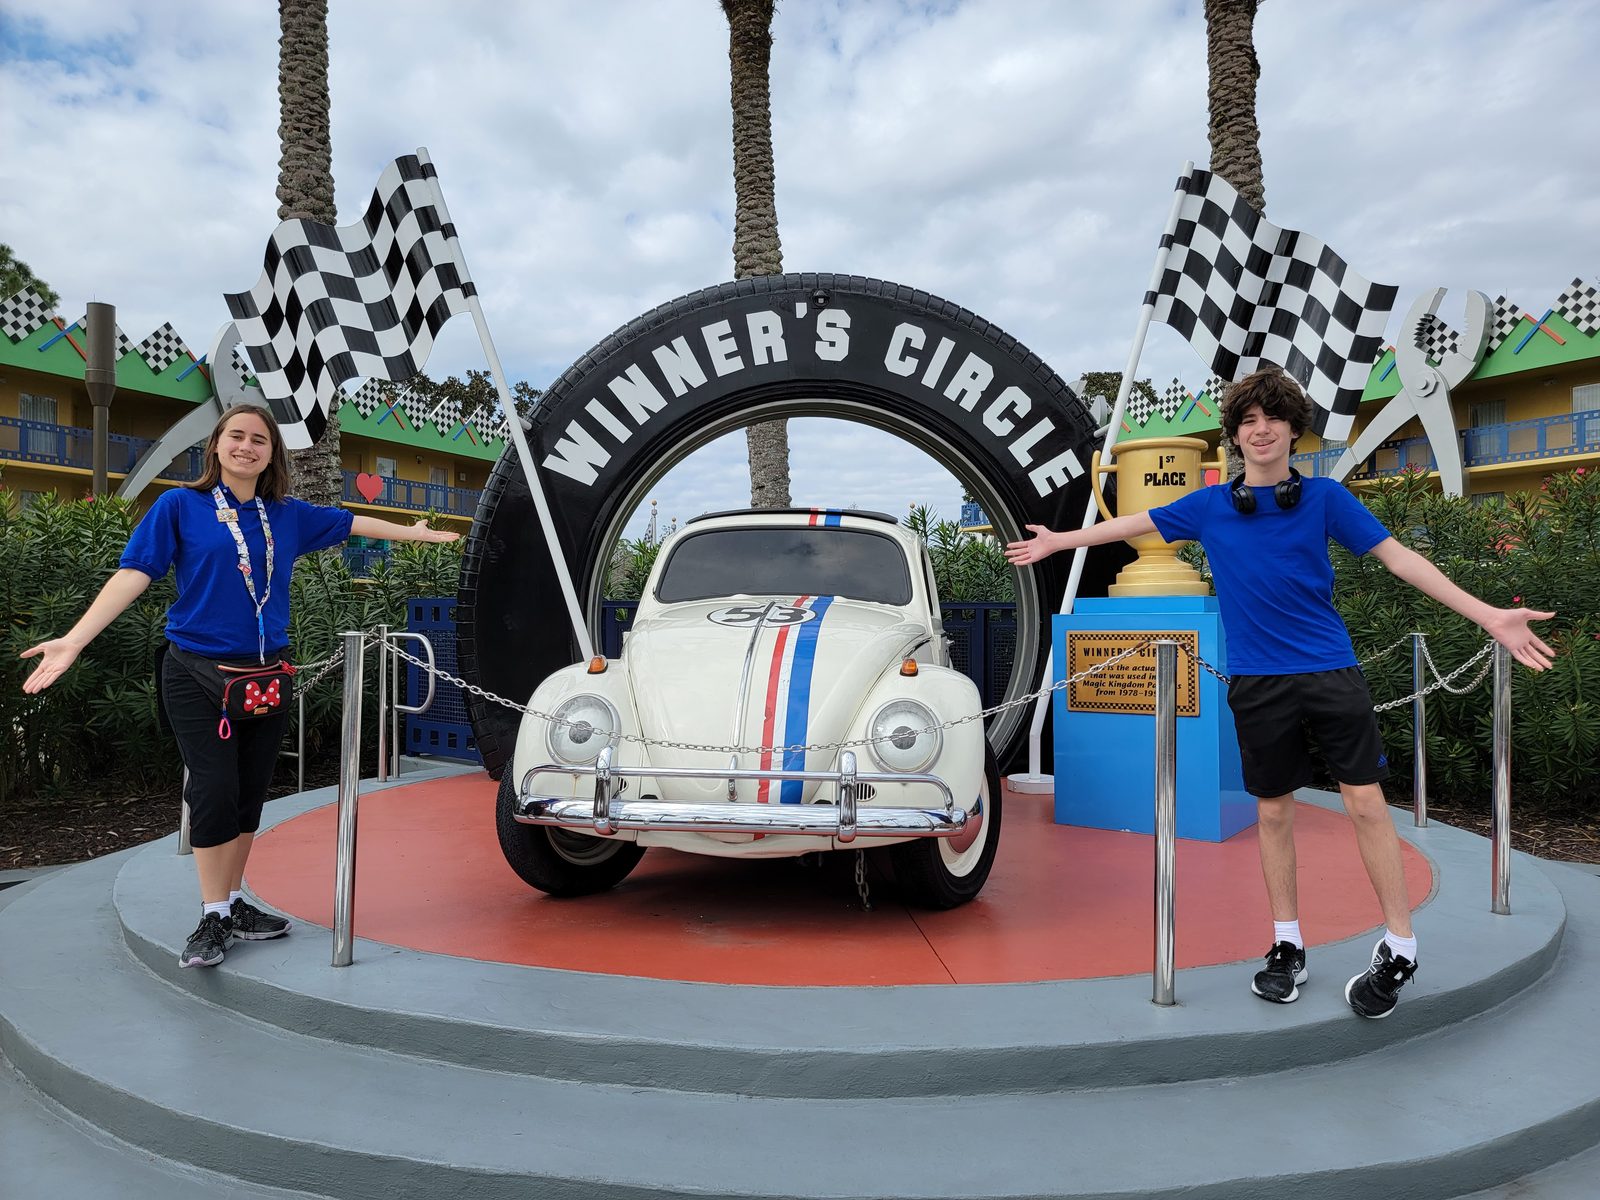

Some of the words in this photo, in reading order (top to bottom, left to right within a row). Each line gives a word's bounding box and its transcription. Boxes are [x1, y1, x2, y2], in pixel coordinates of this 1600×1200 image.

[542, 302, 851, 486] WINNER'S
[884, 322, 1085, 498] CIRCLE
[1144, 471, 1186, 486] PLACE
[721, 605, 807, 623] 53
[1083, 680, 1106, 688] Magic
[1108, 681, 1145, 689] Kingdom
[1095, 688, 1116, 697] from
